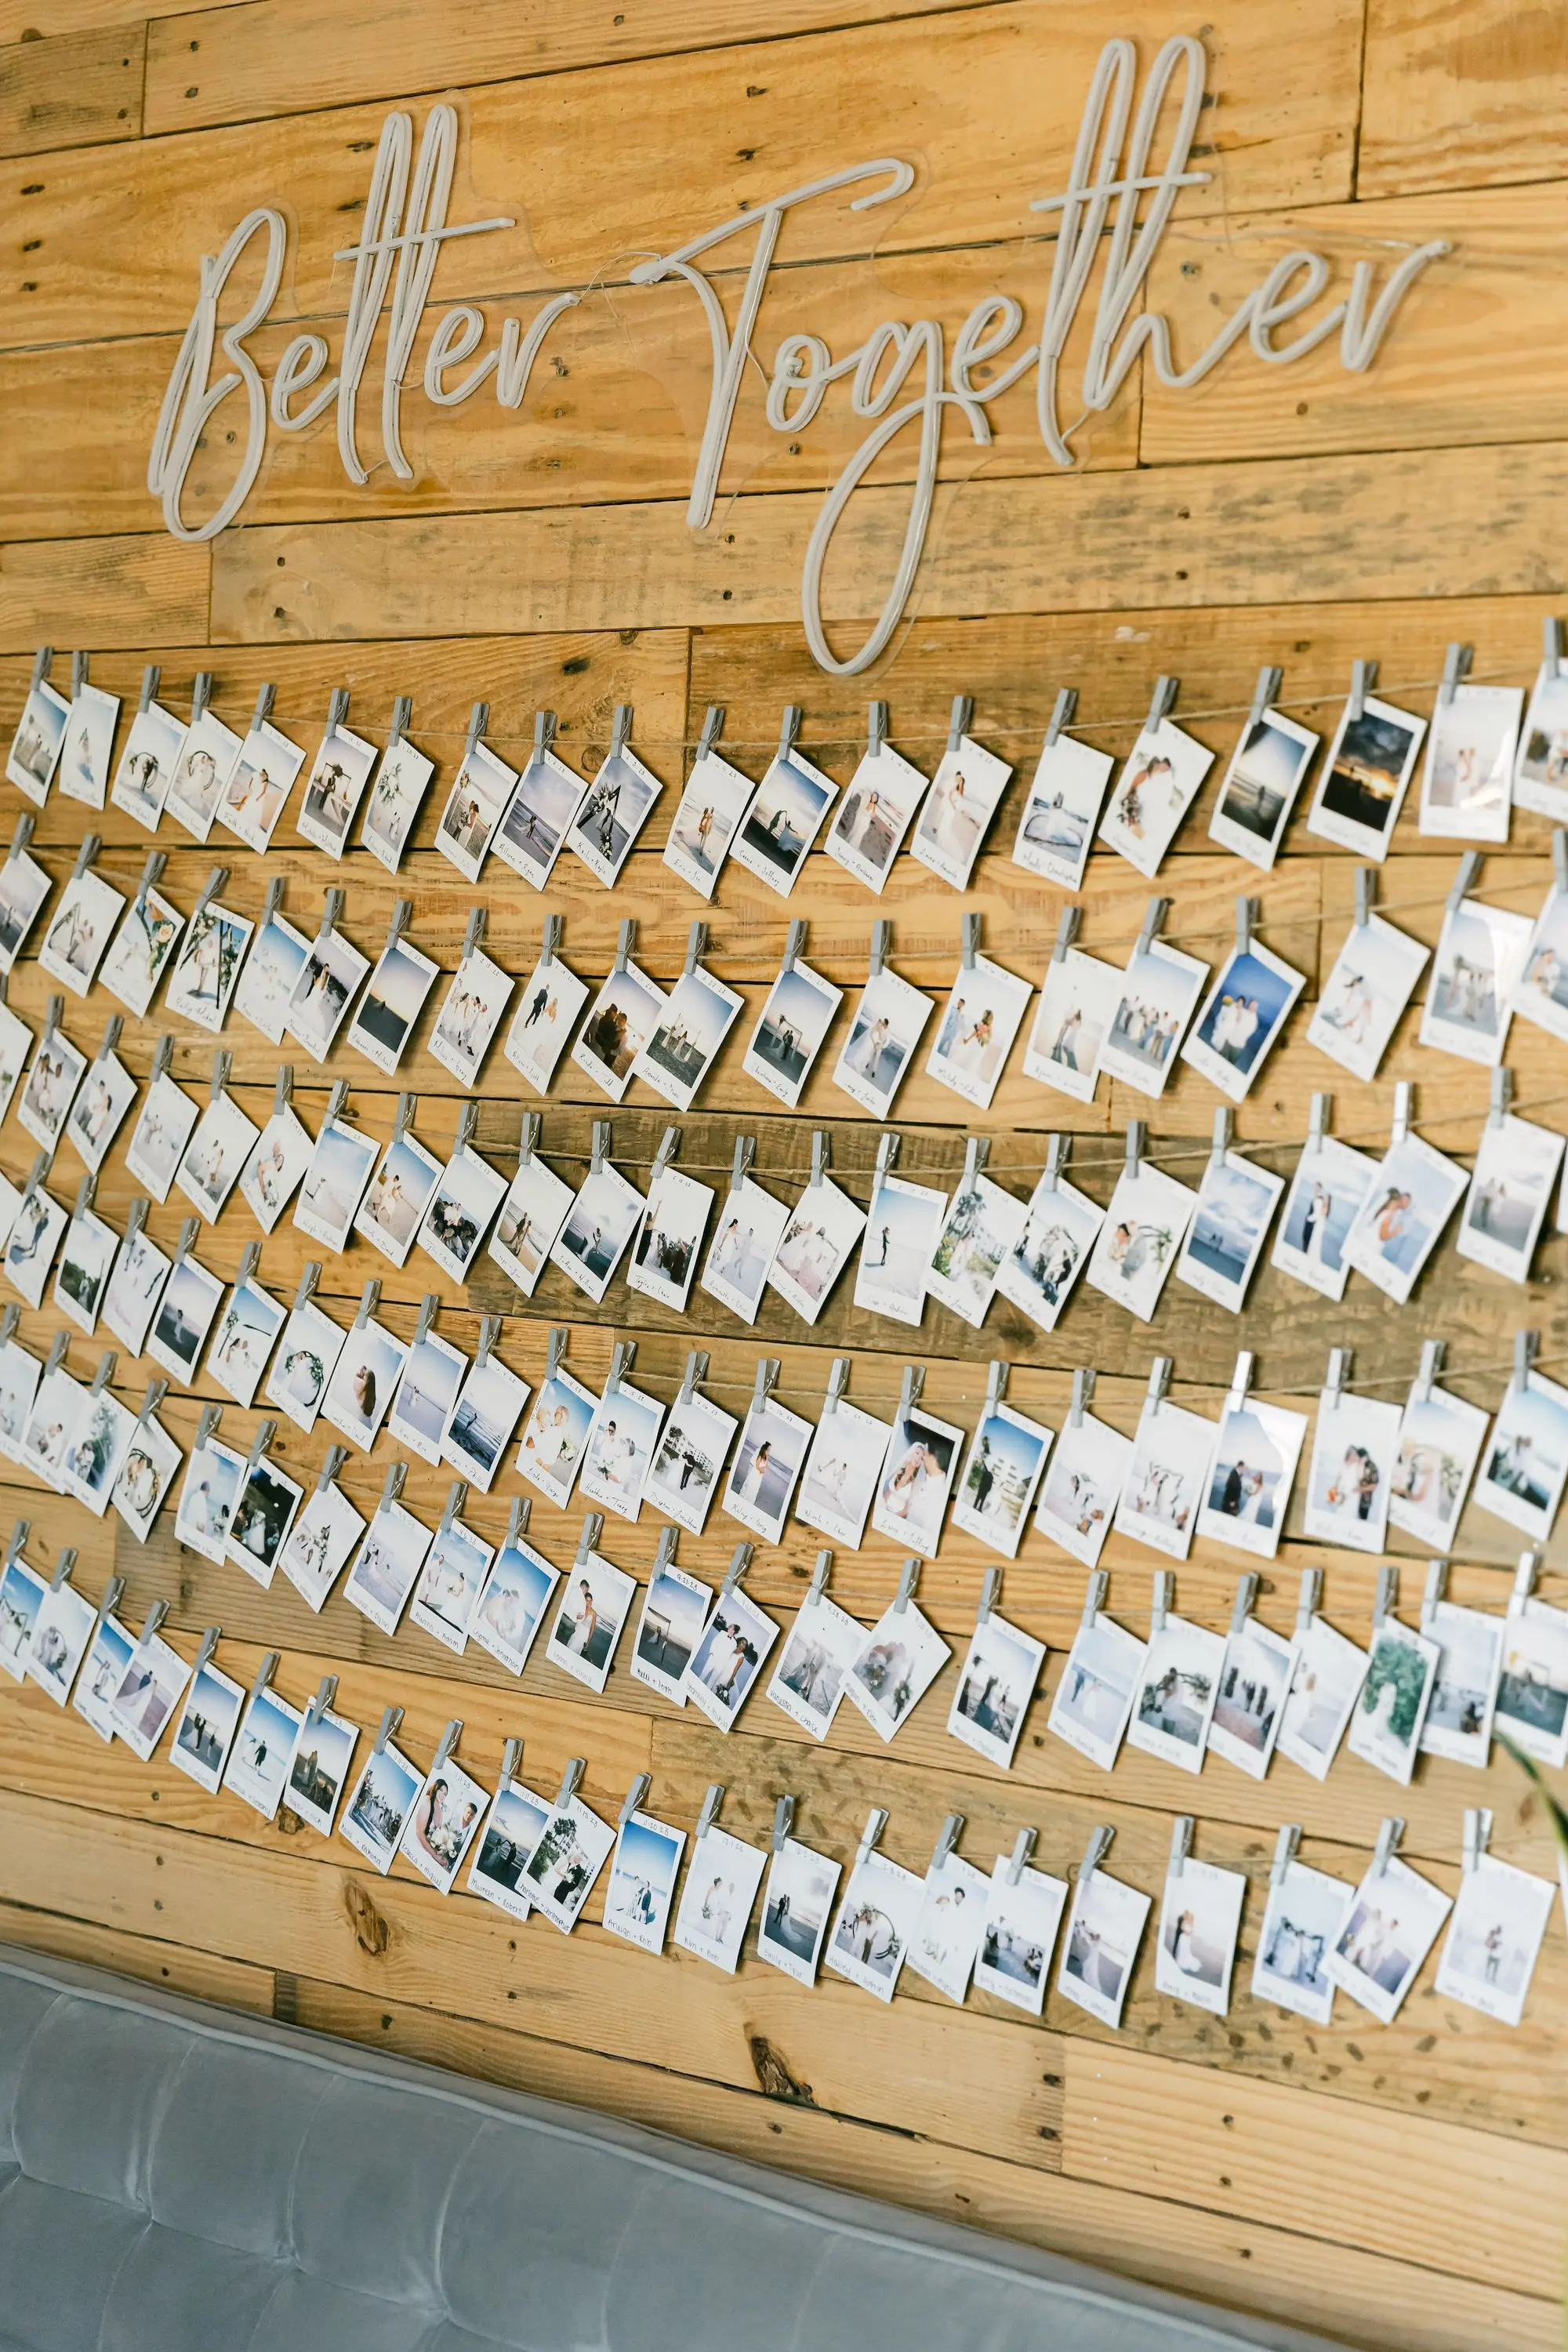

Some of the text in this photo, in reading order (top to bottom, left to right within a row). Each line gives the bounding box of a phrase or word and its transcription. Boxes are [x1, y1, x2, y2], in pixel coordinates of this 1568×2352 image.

[147, 34, 1451, 676] Better Together
[677, 1573, 698, 1591] 9.21.23
